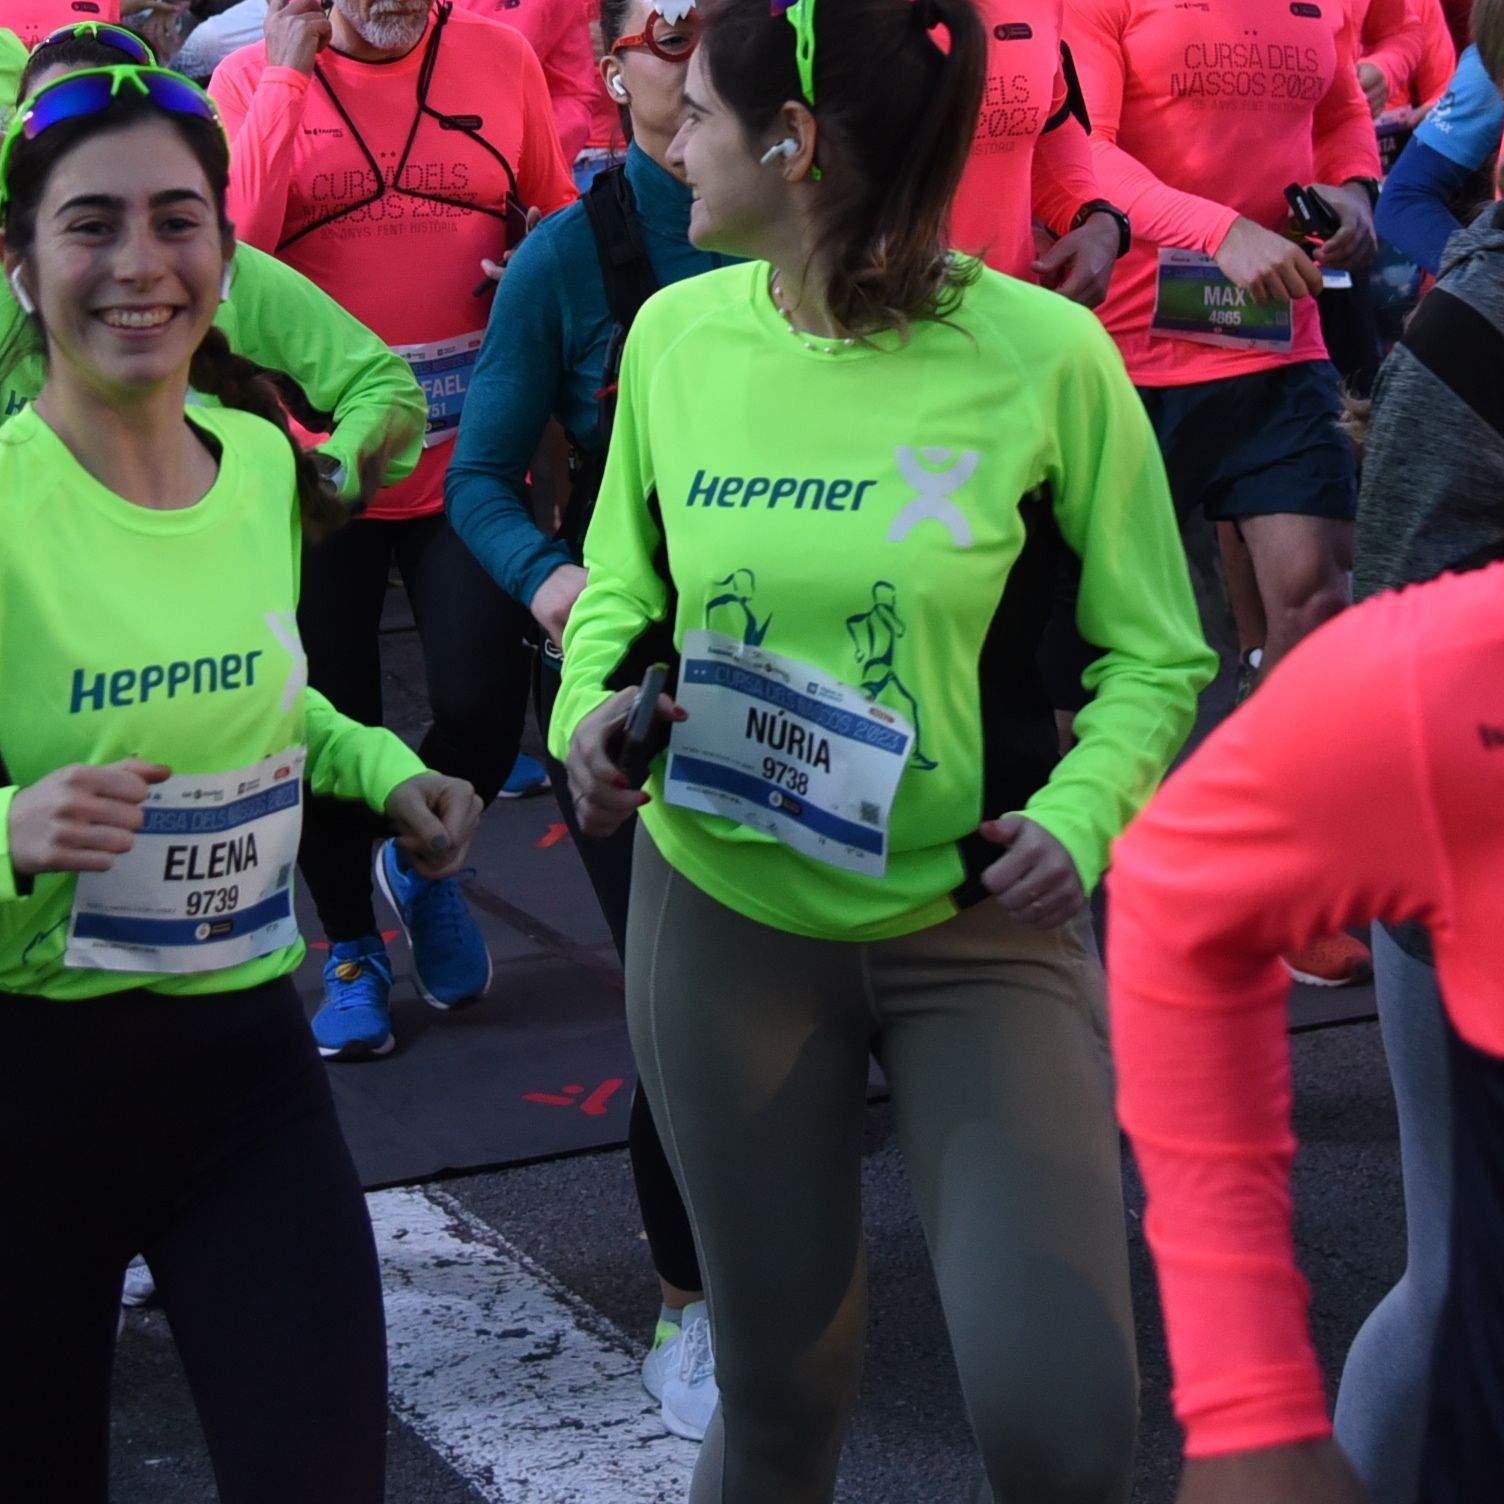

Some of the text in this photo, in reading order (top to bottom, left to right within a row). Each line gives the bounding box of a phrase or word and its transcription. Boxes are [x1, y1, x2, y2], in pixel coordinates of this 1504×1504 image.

[1184, 42, 1320, 74] CURSA DELS
[984, 74, 1030, 107] ELS
[1170, 70, 1267, 98] NASSOS
[311, 163, 469, 202] CURSA DELS
[423, 373, 467, 399] FAEL
[745, 706, 832, 774] NÚRIA
[761, 756, 809, 797] 9738
[162, 831, 259, 883] ELENA
[186, 884, 240, 917] 9739
